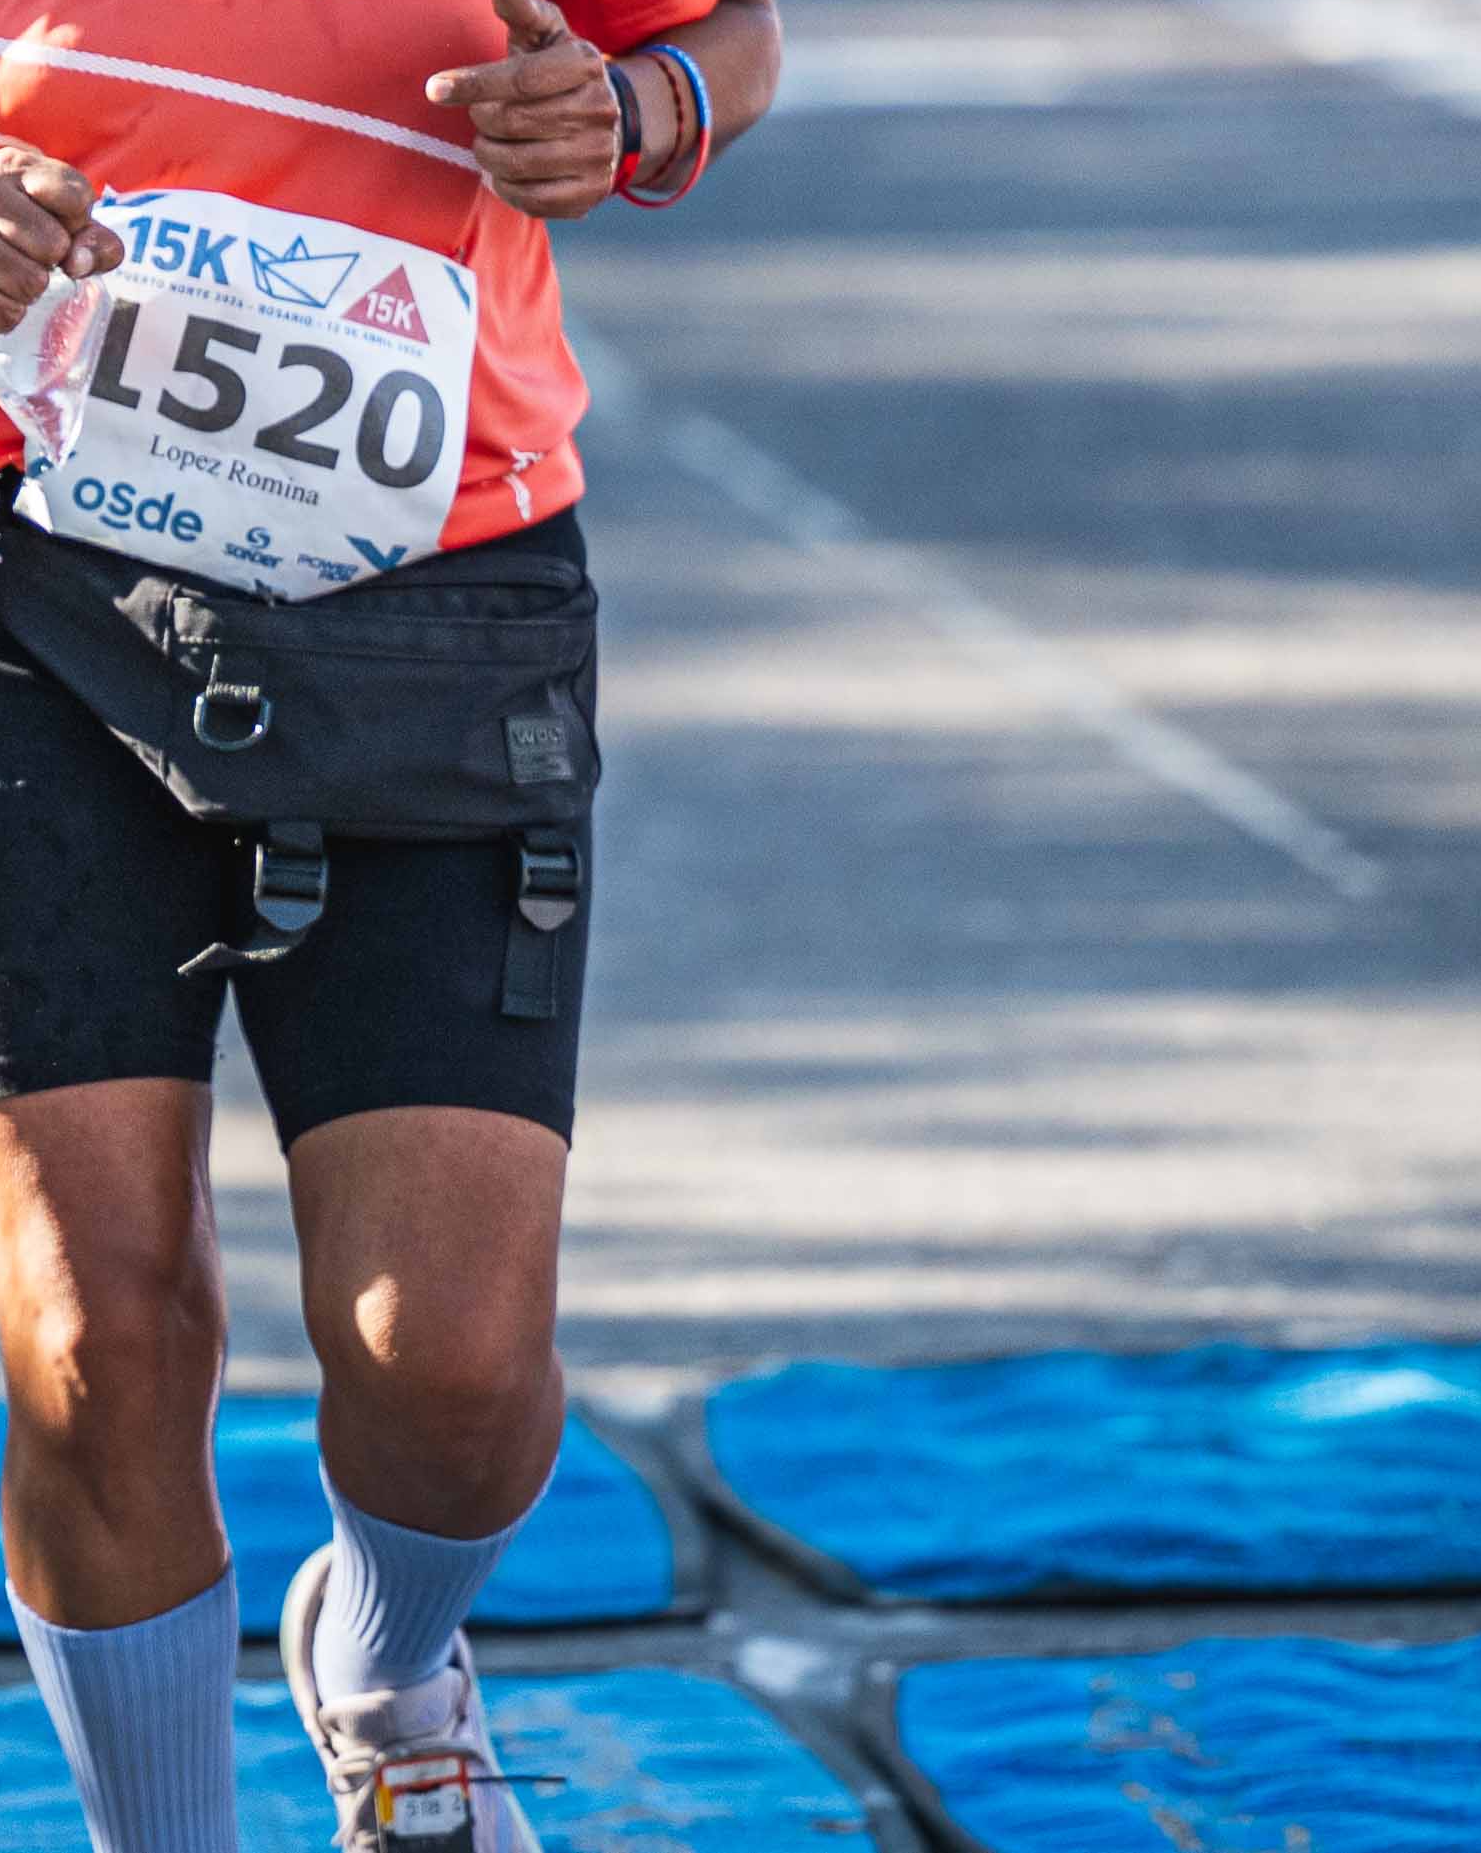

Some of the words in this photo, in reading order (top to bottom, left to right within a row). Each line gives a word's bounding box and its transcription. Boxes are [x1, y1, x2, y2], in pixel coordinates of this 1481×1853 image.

[127, 215, 238, 286] 15K
[169, 282, 211, 299] NORTE
[257, 303, 313, 326] ROSARIO
[365, 291, 417, 331] 15K
[88, 296, 446, 489] 1520
[149, 434, 223, 476] Lopez
[227, 459, 320, 506] Romina
[72, 476, 204, 543] osde
